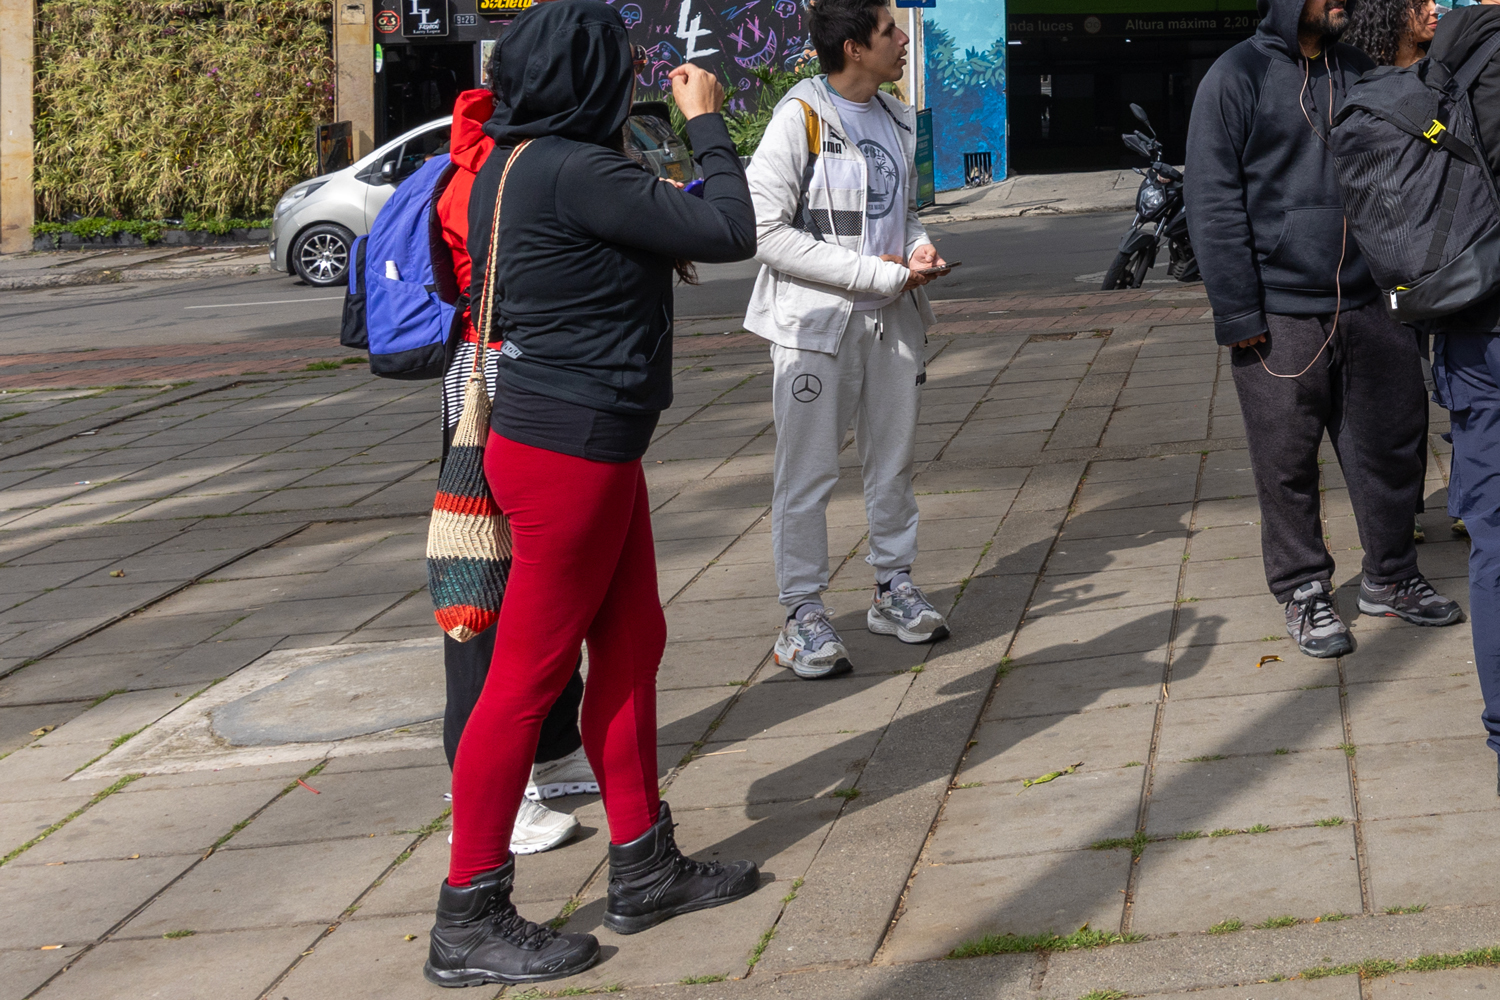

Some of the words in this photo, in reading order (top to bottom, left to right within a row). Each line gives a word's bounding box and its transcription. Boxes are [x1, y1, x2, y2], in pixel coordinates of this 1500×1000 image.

[1039, 20, 1074, 32] luces
[1125, 18, 1164, 30] Altura
[1168, 17, 1217, 29] máxima
[1224, 16, 1249, 29] 2,20
